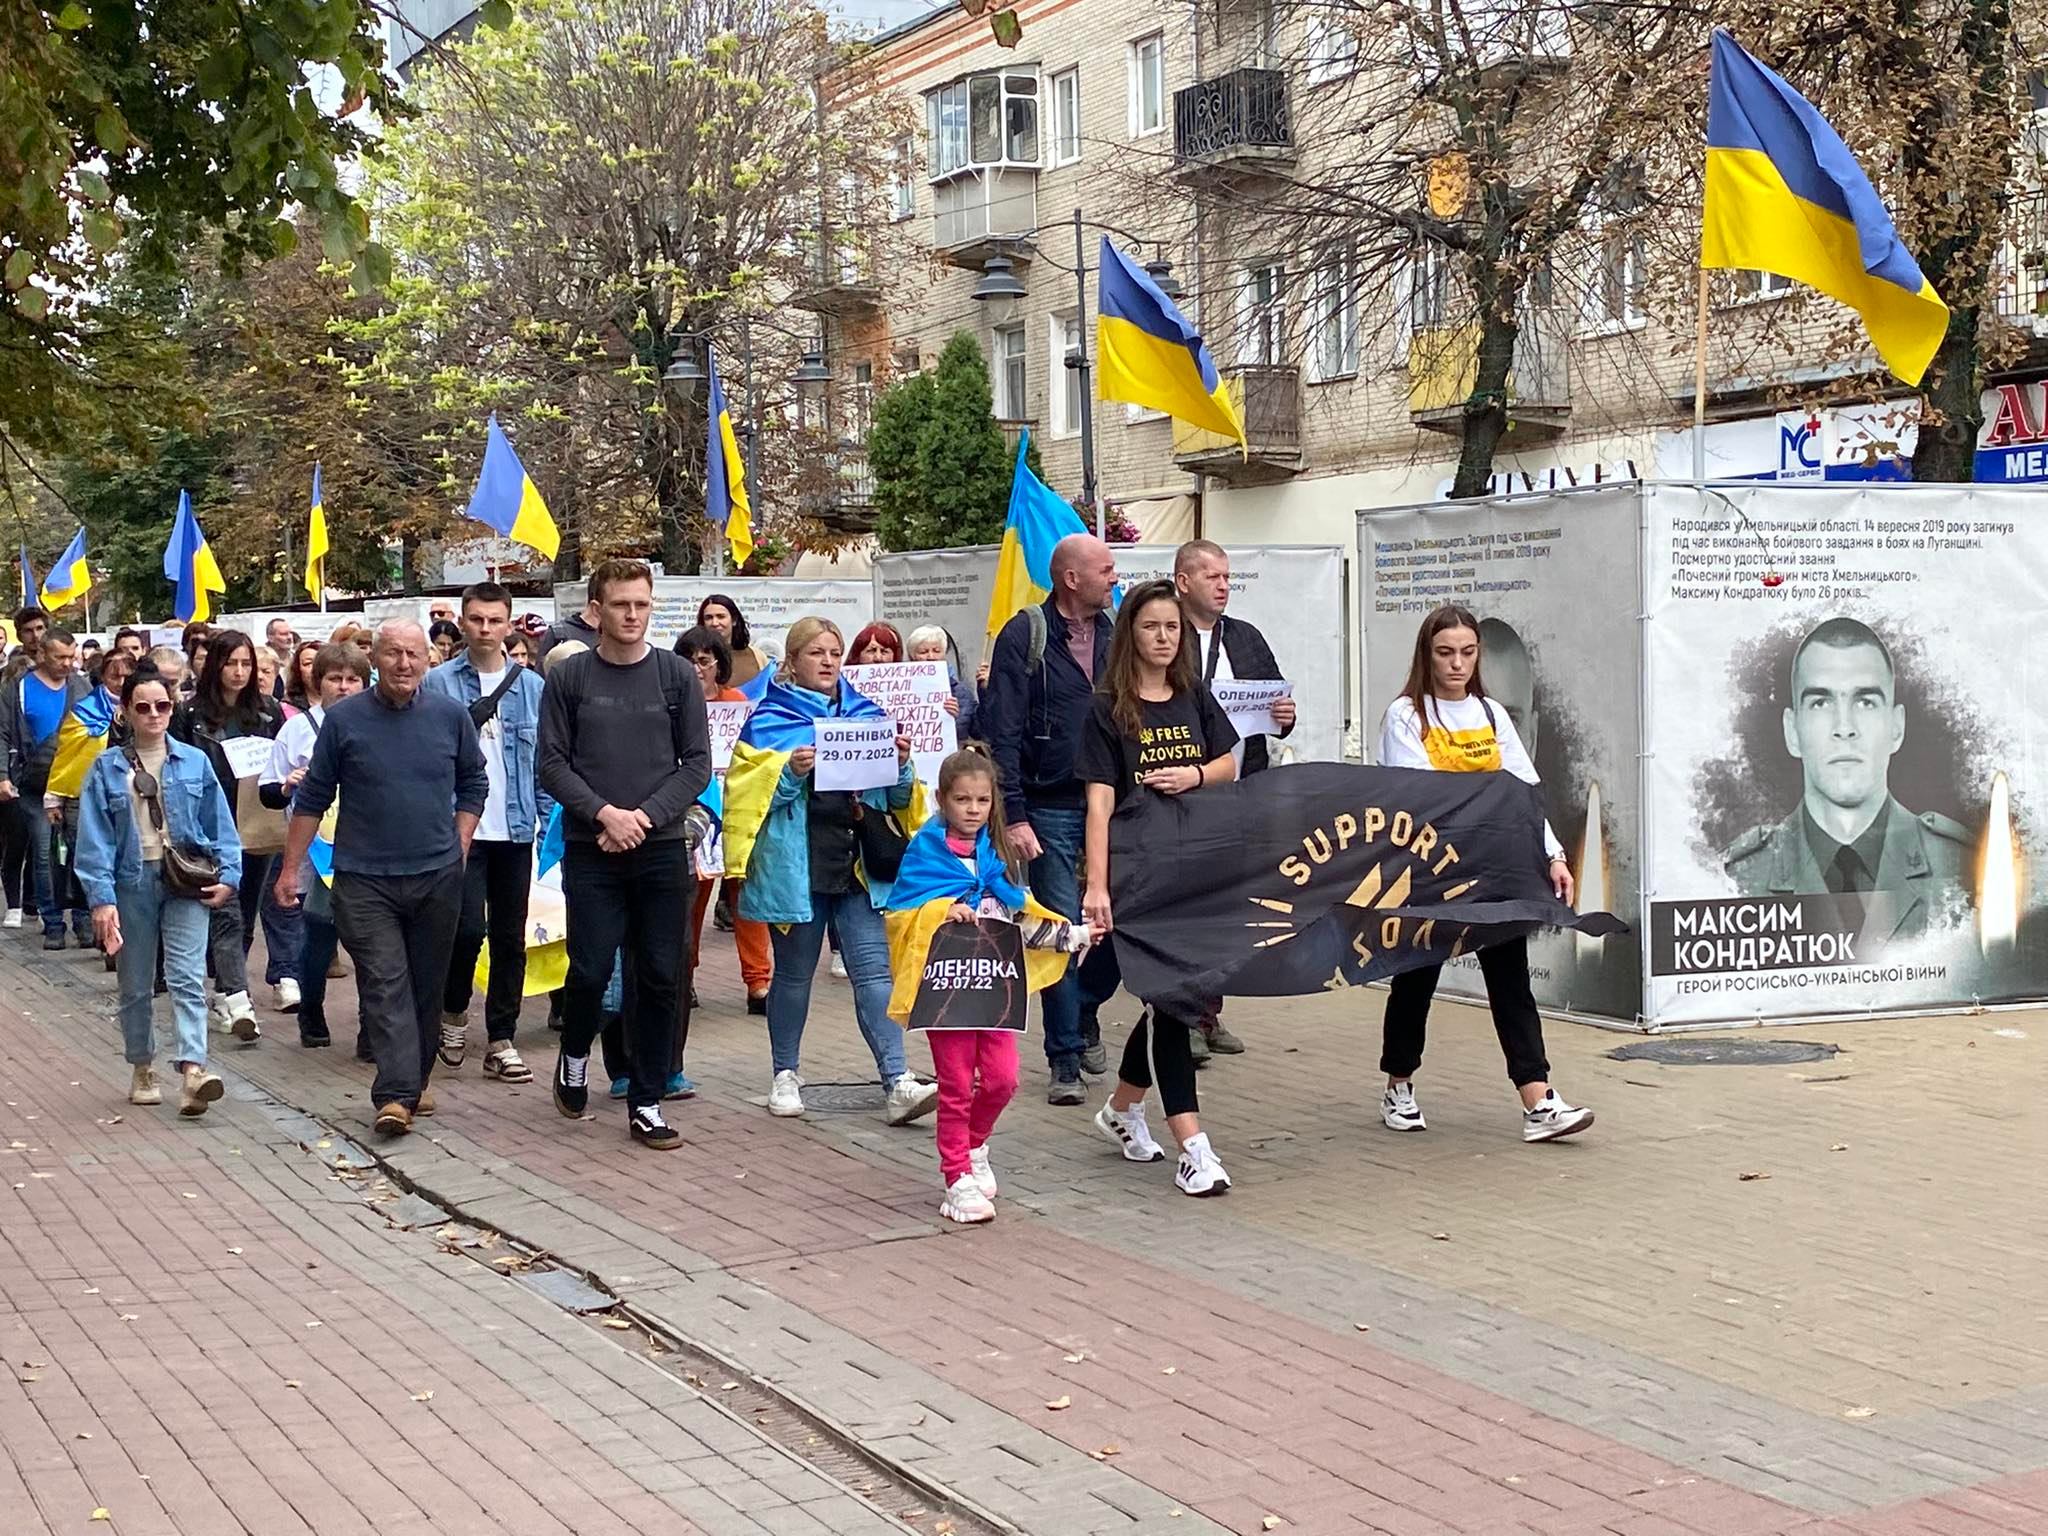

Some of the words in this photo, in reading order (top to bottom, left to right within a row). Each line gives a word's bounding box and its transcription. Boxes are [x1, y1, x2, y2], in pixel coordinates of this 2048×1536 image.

[1985, 380, 2048, 444] А
[2005, 450, 2048, 479] МЕ
[1672, 518, 1730, 534] Народився
[1744, 518, 1817, 533] Хмельницькій
[1820, 518, 1862, 533] області.
[1865, 518, 1875, 533] 14
[1878, 522, 1920, 536] вересня
[1922, 519, 1944, 533] 2019
[1947, 522, 1971, 537] року
[1973, 521, 2014, 536] загинув
[1672, 537, 1689, 550] під
[1693, 538, 1710, 549] час
[1713, 538, 1770, 549] виконання
[1773, 535, 1822, 549] бойового
[1826, 537, 1873, 551] завдання
[1877, 538, 1883, 549] в
[1886, 536, 1910, 549] боях
[1912, 539, 1925, 549] на
[1927, 536, 1983, 551] Луганщині.
[1672, 552, 1731, 567] Посмертно
[1734, 552, 1796, 567] удостоєний
[1799, 554, 1835, 565] звання
[1672, 568, 1730, 582] «Почесний
[1802, 569, 1828, 582] міста
[1671, 586, 1720, 600] Максиму
[1724, 586, 1789, 601] Кондратюку
[1792, 586, 1816, 599] було
[1818, 586, 1831, 599] 26
[852, 680, 911, 694] ЗОВСТАЛІ
[1218, 689, 1284, 701] ОЛЕНІВКА
[823, 728, 894, 743] ОЛЕНІВКА
[1156, 725, 1191, 742] FREE
[822, 747, 895, 762] 29.07.2022
[1139, 744, 1203, 765] AZOVSTAL
[1278, 806, 1460, 886] SUPPORT
[1673, 902, 1804, 936] МАКСИМ
[1673, 932, 1856, 970] КОНДРАТЮК
[923, 959, 1019, 980] ОЛЕНІВКА
[1725, 964, 1904, 991] РОСІЙСЬКО-УКРАЇНСЬКОЇ
[1906, 962, 1947, 981] ВІЙНИ
[931, 977, 993, 991] 29.07.22
